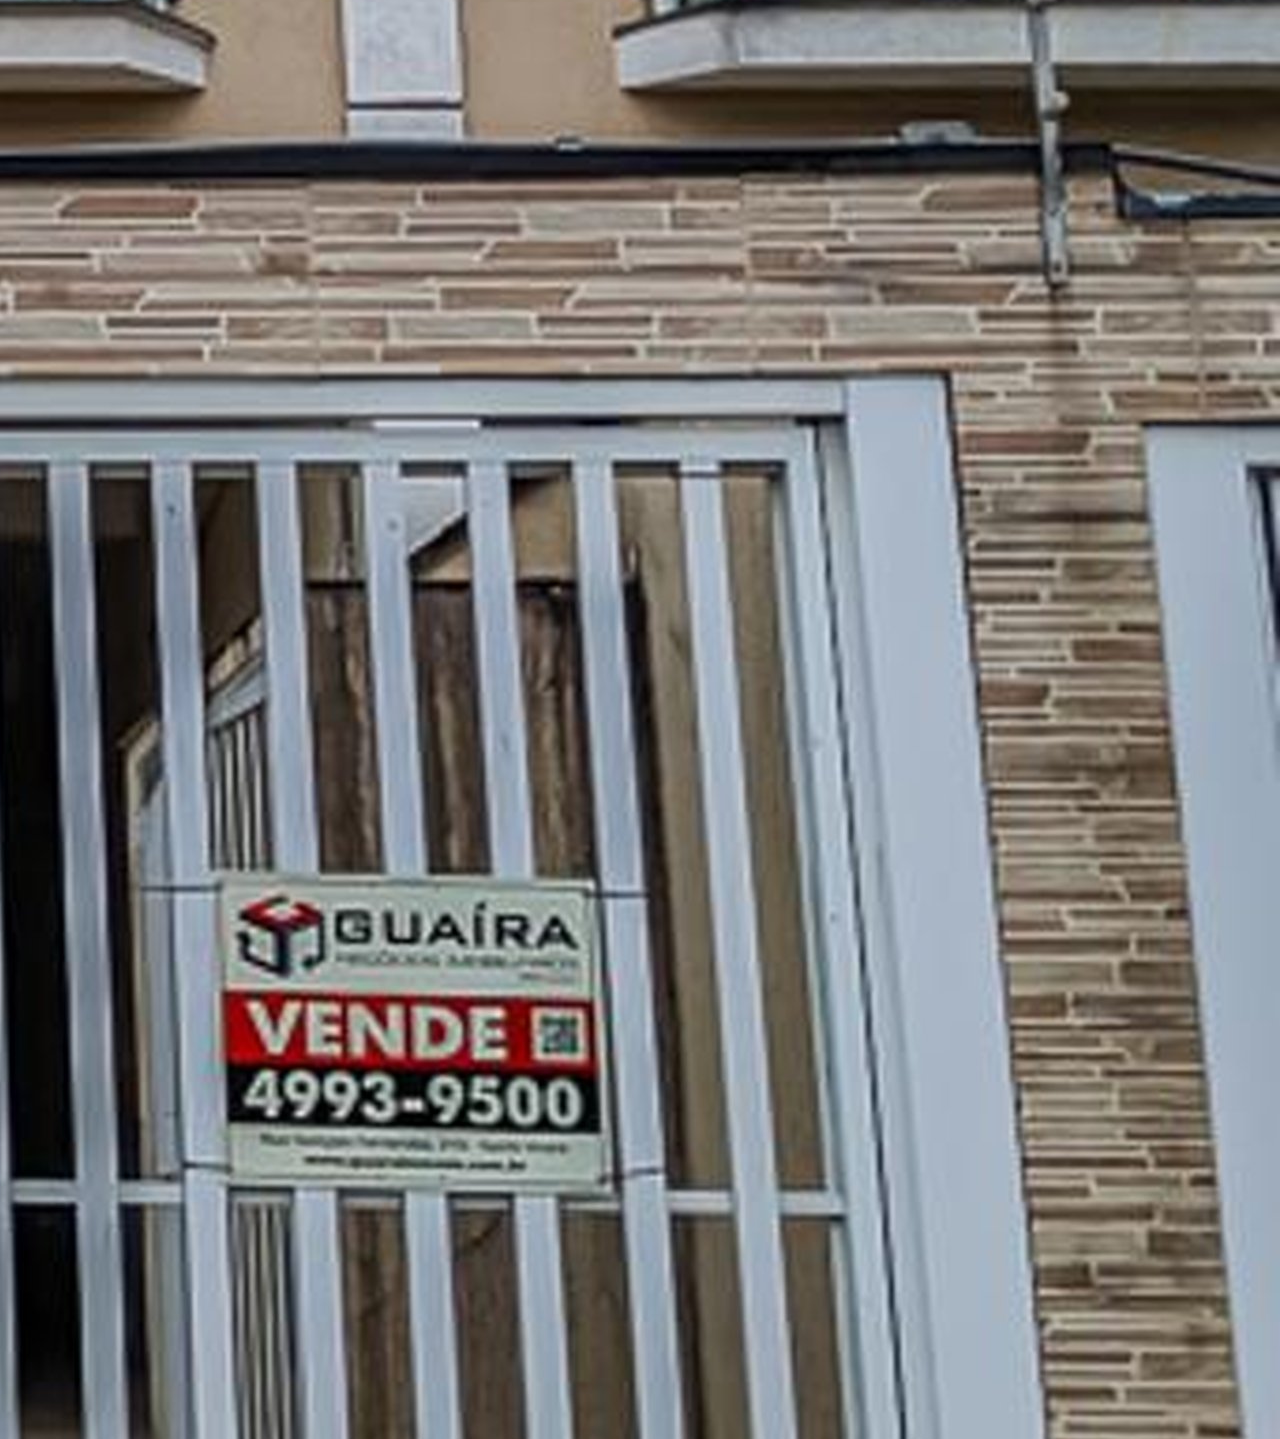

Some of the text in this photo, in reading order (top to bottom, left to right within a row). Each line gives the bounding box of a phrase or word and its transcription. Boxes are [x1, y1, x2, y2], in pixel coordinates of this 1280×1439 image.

[335, 901, 580, 950] GUAÍRA
[244, 999, 509, 1063] VENDE
[243, 1070, 583, 1127] 4993-9500
